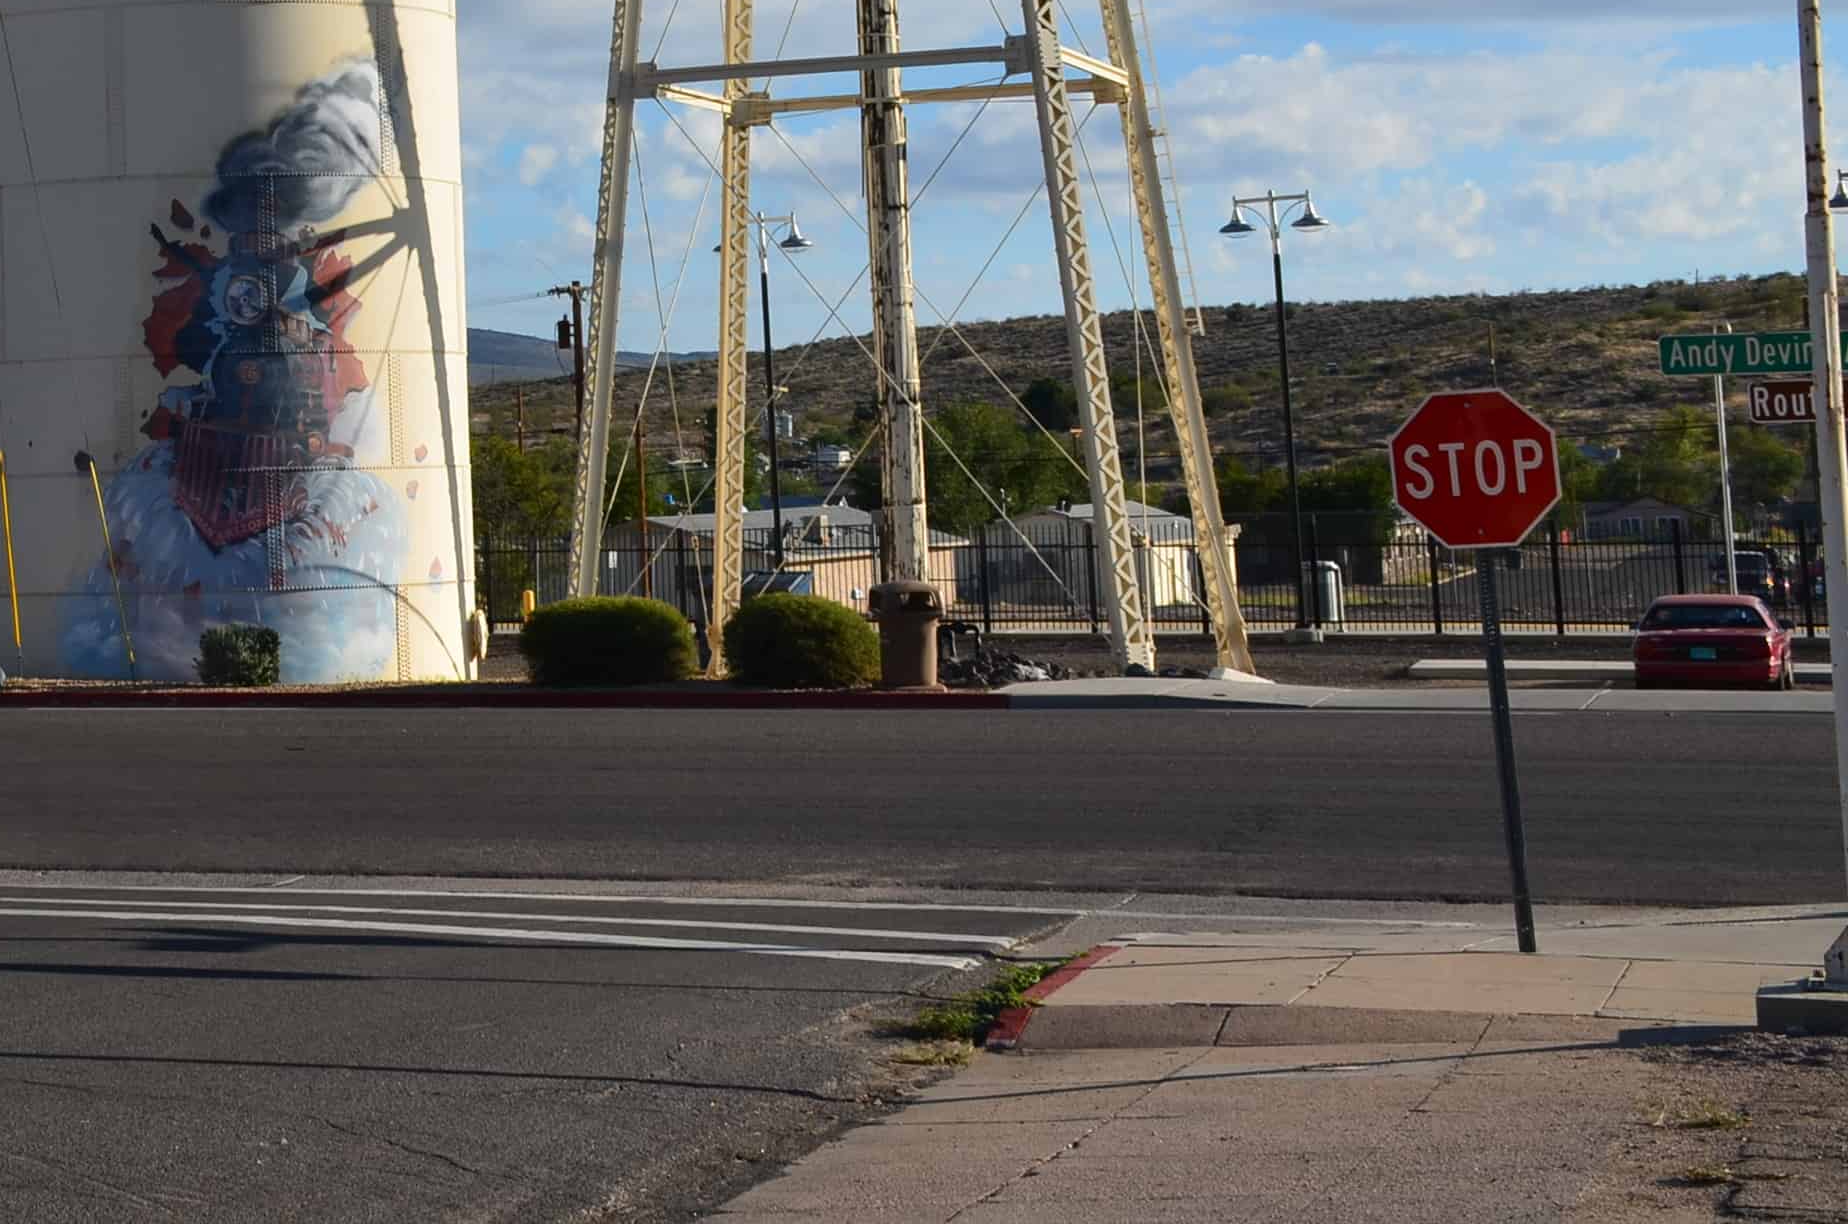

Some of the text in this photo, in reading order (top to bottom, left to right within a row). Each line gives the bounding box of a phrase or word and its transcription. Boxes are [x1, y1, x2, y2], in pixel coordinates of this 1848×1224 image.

[1670, 339, 1735, 373] Andy
[1745, 336, 1816, 366] Devin
[1753, 386, 1816, 417] Rout
[1404, 438, 1544, 500] STOP
